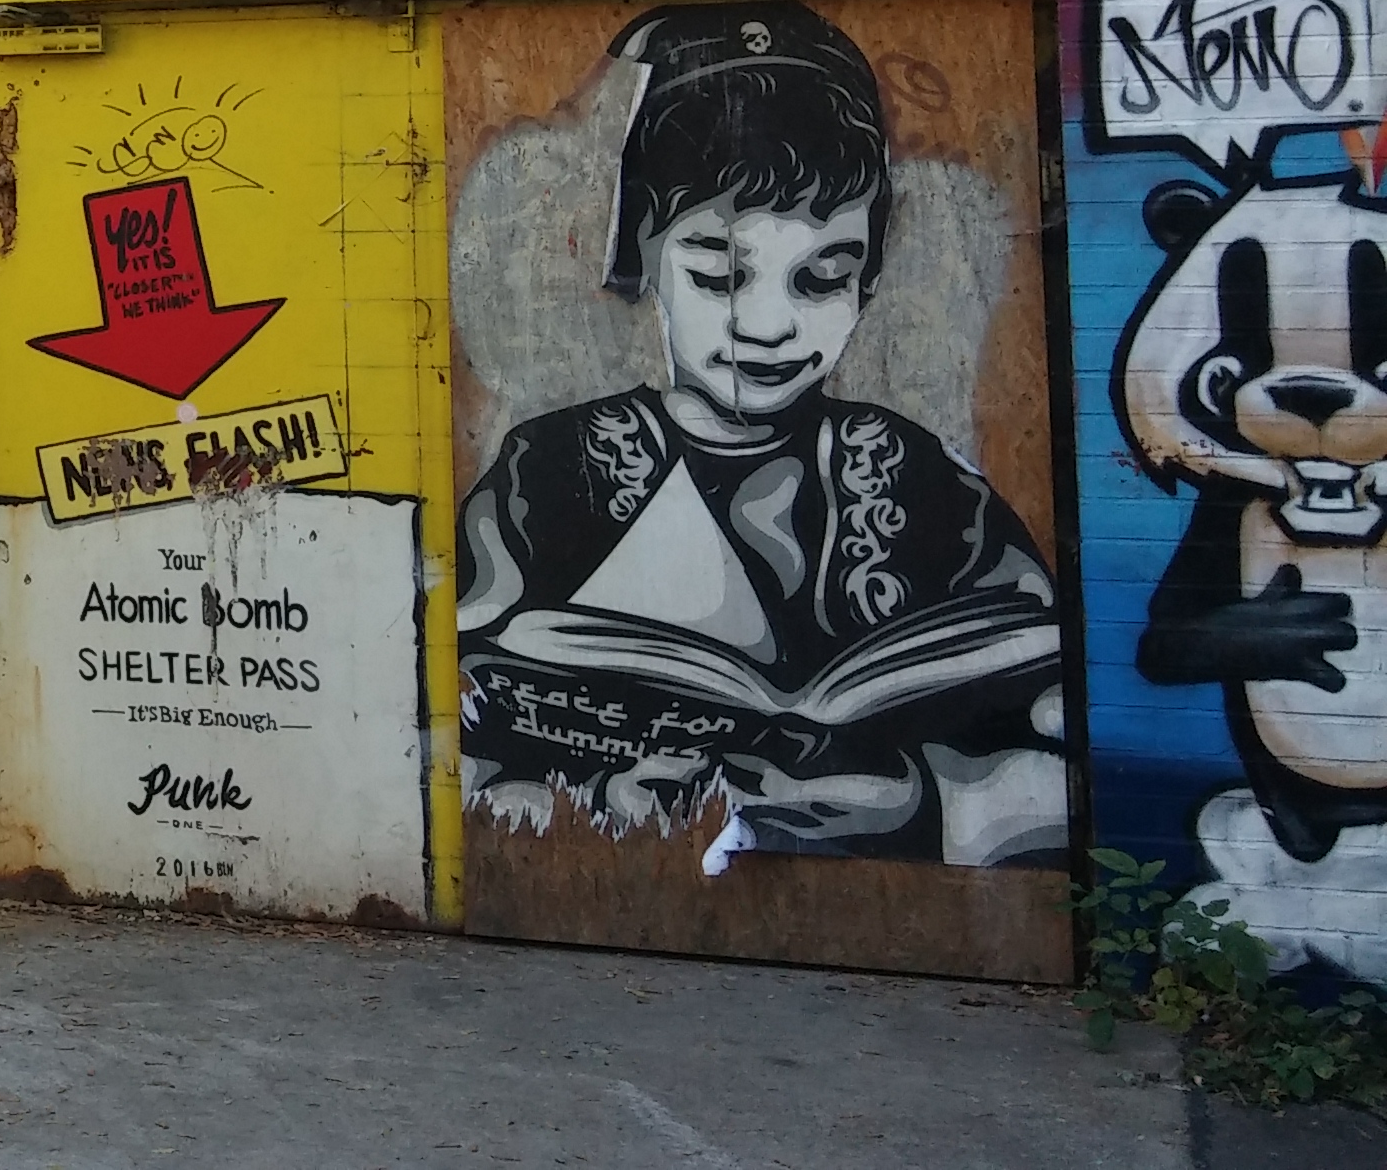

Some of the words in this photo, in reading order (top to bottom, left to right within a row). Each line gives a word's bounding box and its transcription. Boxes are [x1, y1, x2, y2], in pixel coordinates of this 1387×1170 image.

[132, 255, 150, 271] IT
[153, 246, 176, 270] IS
[158, 548, 207, 571] Your
[80, 581, 189, 625] Atomic
[200, 581, 309, 633] Bomb
[78, 647, 231, 687] SHELTER
[240, 656, 321, 692] PASS
[160, 705, 194, 726] Big
[198, 708, 279, 734] Enough
[127, 763, 253, 816] Punk
[172, 819, 204, 830] ONE
[155, 856, 214, 877] 2016
